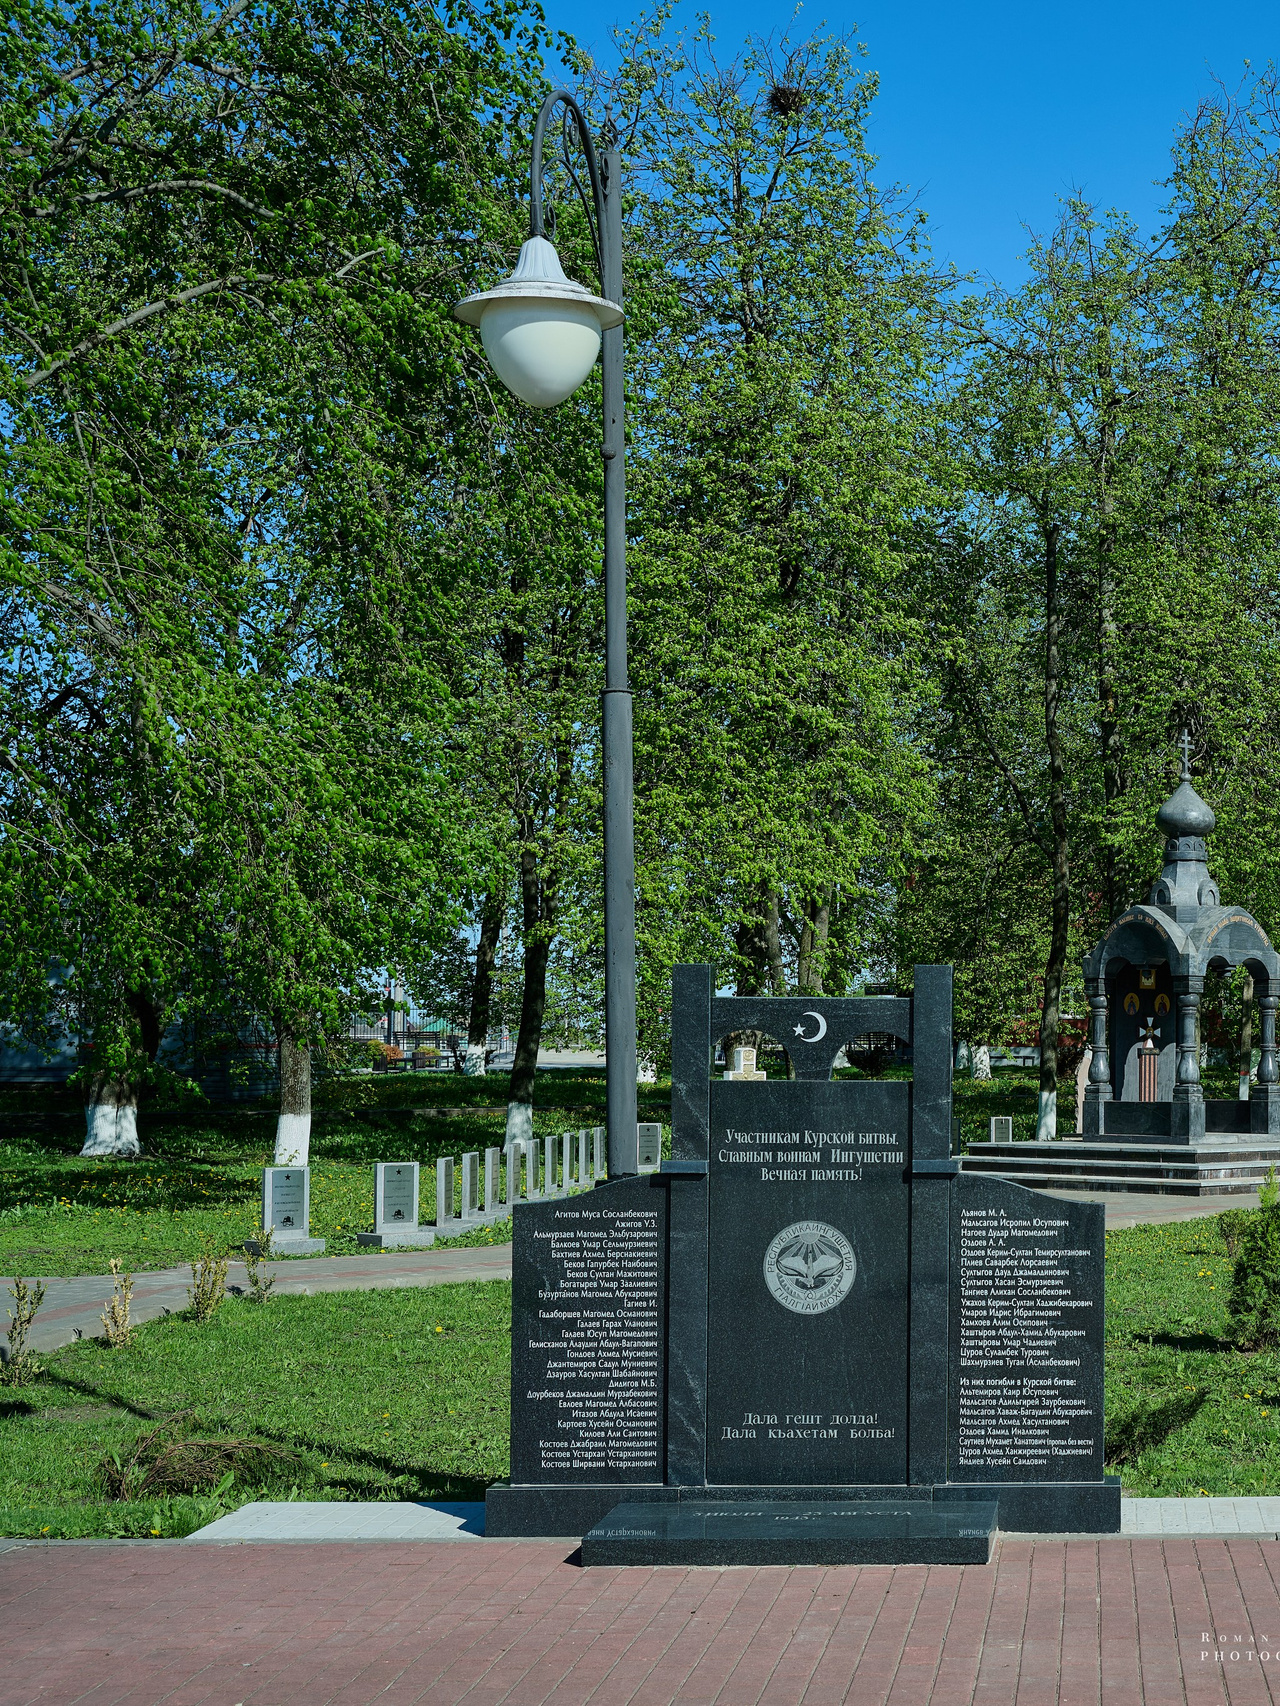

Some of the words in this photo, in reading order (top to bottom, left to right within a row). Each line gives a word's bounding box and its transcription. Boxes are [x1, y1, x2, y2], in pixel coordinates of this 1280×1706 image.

[725, 1129, 800, 1144] Участникам
[804, 1129, 855, 1148] Курской
[718, 1149, 772, 1163] Славным
[777, 1151, 821, 1163] воинам
[831, 1149, 904, 1166] Ингушетии
[761, 1168, 806, 1181] Вечная
[811, 1168, 863, 1181] память!
[555, 1210, 579, 1218] Агитов
[582, 1210, 600, 1220] Муса
[603, 1209, 657, 1218] Сосланбекович
[615, 1220, 642, 1228] Ажигов
[961, 1219, 998, 1227] Мальсагов
[1033, 1219, 1068, 1229] Юсупович
[961, 1229, 986, 1237] Нагоев
[988, 1229, 1008, 1239] Дудар
[1011, 1229, 1057, 1237] Магомедович
[551, 1240, 579, 1248] Балкоев
[583, 1240, 600, 1250] Умар
[603, 1240, 657, 1250] Сельмурзиевич
[961, 1238, 986, 1246] Оздоев
[552, 1250, 580, 1258] Бахтиев
[583, 1250, 604, 1258] Ахмед
[564, 1260, 585, 1268] Беков
[587, 1259, 620, 1270] Гапурбек
[622, 1259, 657, 1268] Наибович
[961, 1258, 982, 1266] Плиев
[985, 1258, 1018, 1268] Саварбек
[567, 1270, 587, 1278] Беков
[590, 1270, 614, 1280] Султан
[617, 1270, 657, 1278] Мажитович
[961, 1268, 992, 1278] Султыгов
[995, 1268, 1011, 1278] Дауд
[1013, 1268, 1069, 1276] Джамалдинович
[560, 1280, 597, 1290] Богатырев
[600, 1280, 618, 1290] Умар
[961, 1278, 992, 1288] Султыгов
[995, 1278, 1015, 1286] Хасан
[961, 1288, 988, 1296] Тангиев
[990, 1288, 1015, 1296] Алихан
[1018, 1287, 1070, 1296] Сосланбекович
[624, 1300, 646, 1308] Гагиев
[961, 1309, 987, 1318] Умаров
[990, 1309, 1011, 1318] Идрис
[1014, 1308, 1061, 1318] Ибрагимович
[578, 1320, 600, 1328] Галаев
[603, 1320, 621, 1330] Гарах
[961, 1318, 990, 1326] Хамхоев
[993, 1318, 1010, 1326] Алим
[1013, 1318, 1047, 1326] Осипович
[562, 1330, 584, 1338] Галаев
[587, 1330, 606, 1340] Юсуп
[610, 1330, 657, 1338] Магомедович
[567, 1350, 595, 1358] Гондоев
[598, 1350, 619, 1358] Ахмед
[622, 1350, 657, 1360] Мусиевич
[961, 1348, 983, 1358] Цуров
[985, 1348, 1018, 1358] Суламбек
[1022, 1348, 1049, 1358] Турович
[961, 1358, 1003, 1368] Шахмурзиев
[1006, 1358, 1024, 1368] Туган
[1027, 1358, 1080, 1368] (Асланбекович)
[547, 1370, 576, 1380] Дзауров
[579, 1370, 610, 1380] Хасултан
[609, 1380, 638, 1388] Дидигов
[960, 1378, 969, 1386] Из
[987, 1377, 1014, 1386] погибли
[1024, 1377, 1051, 1388] Курской
[960, 1388, 1001, 1398] Альтемиров
[1003, 1388, 1020, 1398] Каир
[1023, 1388, 1058, 1398] Юсупович
[960, 1398, 996, 1406] Мальсагов
[999, 1397, 1039, 1408] Адильгирей
[1042, 1397, 1085, 1408] Заурбекович
[627, 1410, 656, 1418] Исаевич
[742, 1412, 778, 1426] Дала
[785, 1414, 822, 1424] гешт
[830, 1413, 878, 1425] долда!
[558, 1420, 586, 1430] Картоев
[589, 1419, 613, 1430] Хусейн
[616, 1420, 656, 1428] Османович
[1023, 1418, 1069, 1427] Хасултанович
[607, 1430, 620, 1438] Али
[721, 1427, 756, 1440] Дала
[768, 1428, 838, 1439] къахетам
[960, 1427, 985, 1435] Оздоев
[987, 1427, 1009, 1435] Хамид
[540, 1440, 568, 1448] Костоев
[570, 1439, 606, 1450] Джабраил
[609, 1440, 656, 1448] Магомедович
[542, 1450, 570, 1458] Костоев
[573, 1450, 605, 1460] Устархан
[608, 1450, 656, 1460] Устарханович
[960, 1447, 980, 1457] Цуров
[983, 1447, 1003, 1455] Ахмед
[1052, 1446, 1092, 1457] (Хаджиевич)
[542, 1460, 570, 1468] Костоев
[608, 1460, 656, 1470] Устарханович
[959, 1457, 984, 1465] Яндиев
[987, 1457, 1010, 1467] Хусейн
[1013, 1457, 1046, 1465] Саидович
